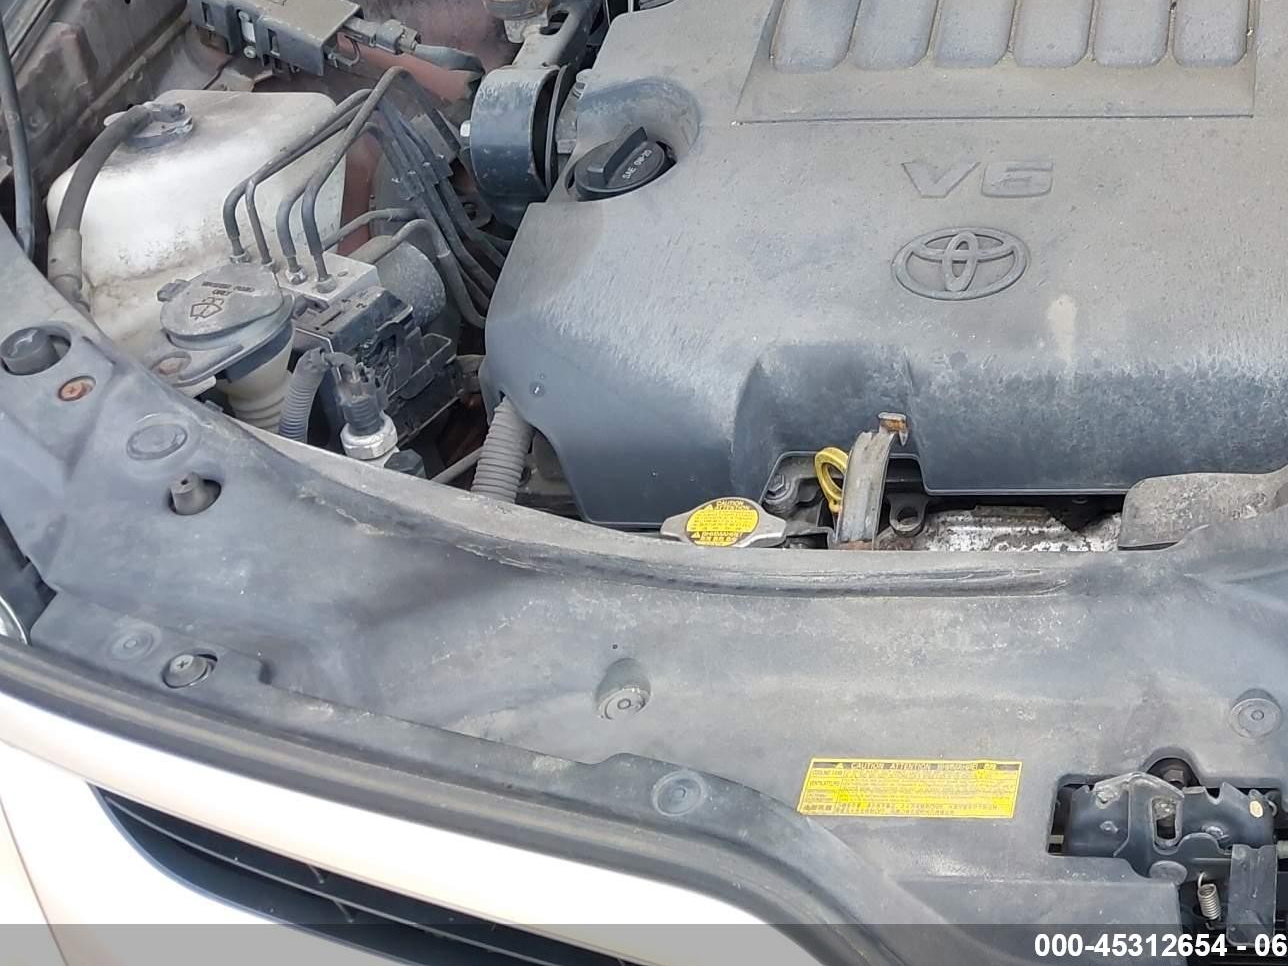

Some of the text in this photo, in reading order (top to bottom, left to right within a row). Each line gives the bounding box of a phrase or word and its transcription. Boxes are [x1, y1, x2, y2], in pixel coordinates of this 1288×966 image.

[621, 166, 637, 179] SAE
[901, 161, 1054, 199] V6
[850, 762, 884, 770] CAUTION
